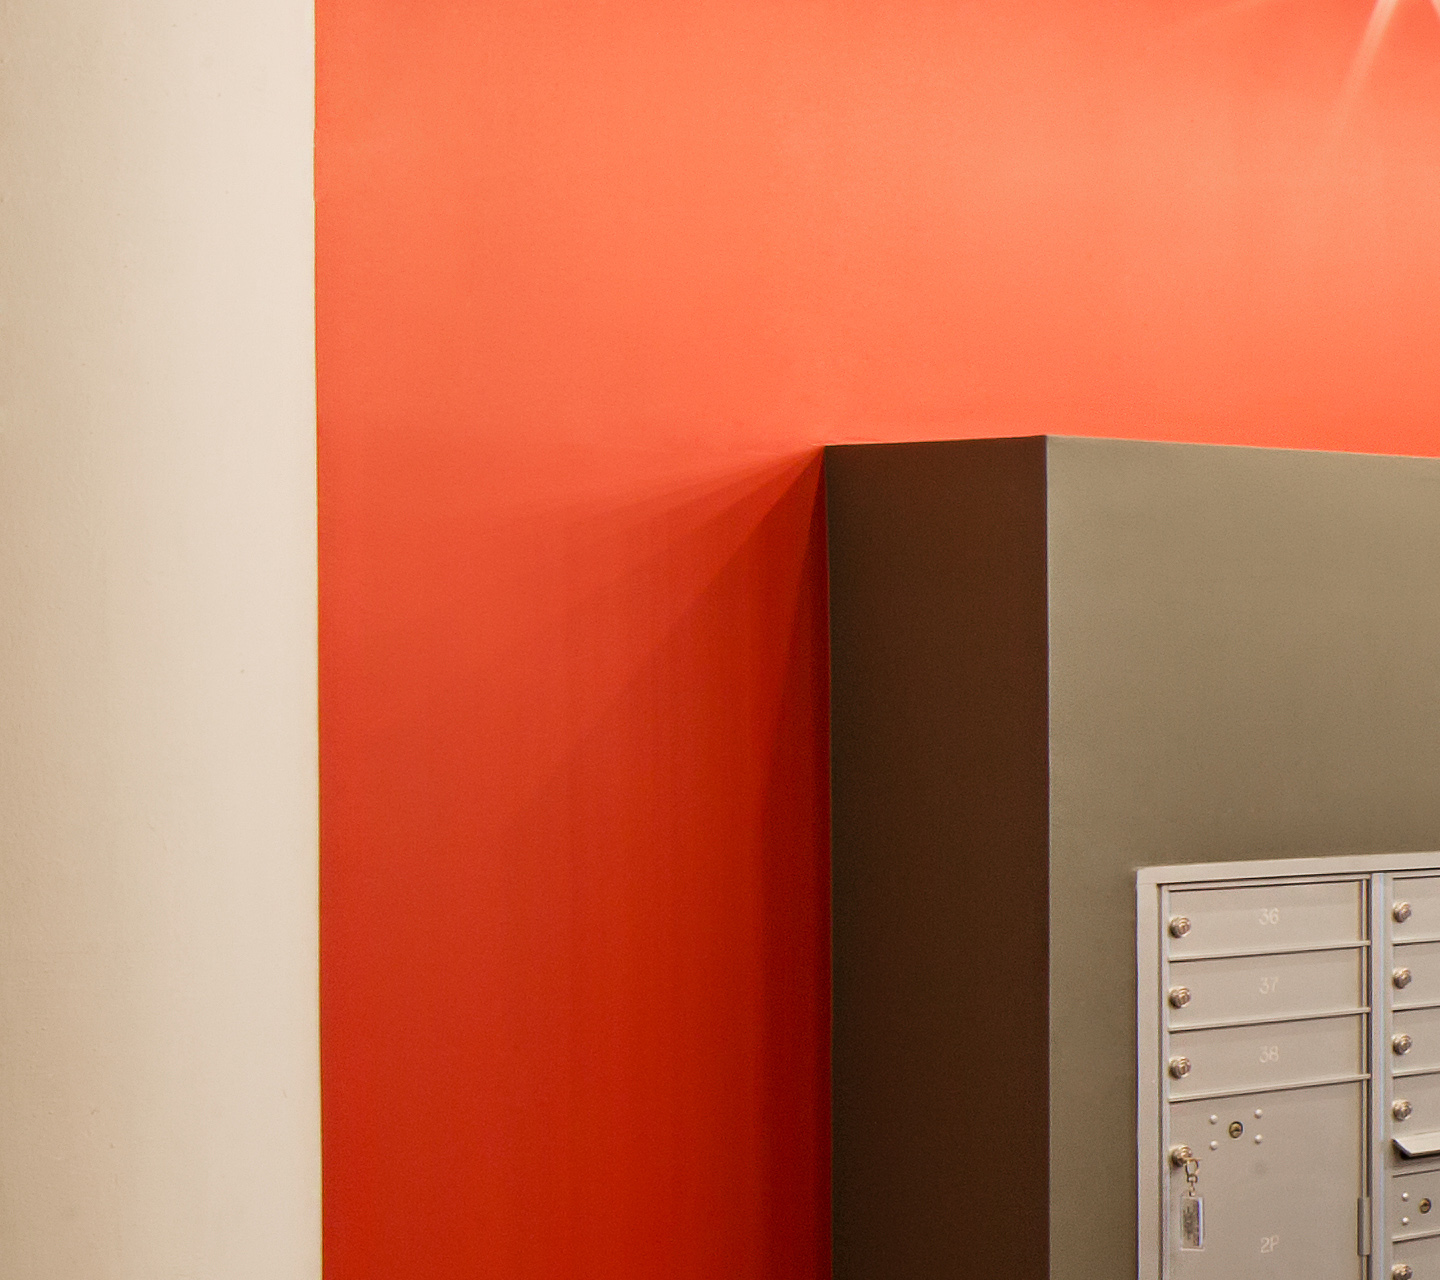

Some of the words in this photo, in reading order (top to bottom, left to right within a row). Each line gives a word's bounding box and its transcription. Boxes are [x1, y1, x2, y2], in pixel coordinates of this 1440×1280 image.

[1258, 907, 1280, 926] 36
[1258, 976, 1280, 994] 37
[1258, 1045, 1280, 1063] 38
[1260, 1234, 1280, 1254] 2P
